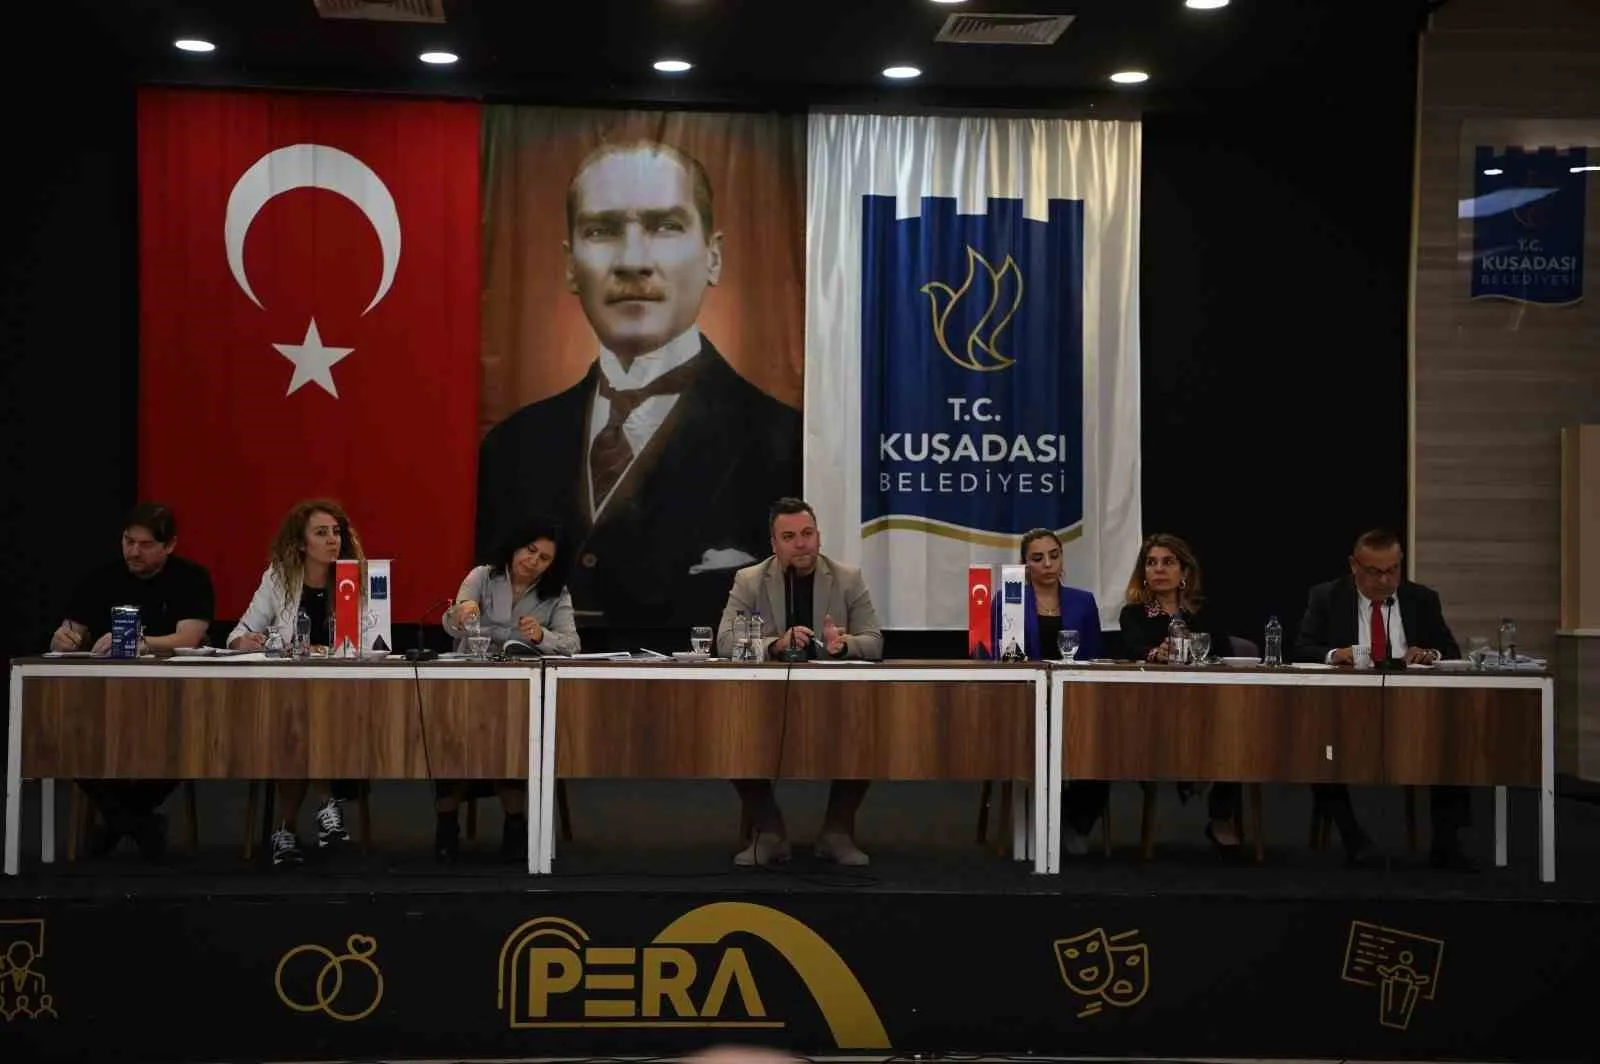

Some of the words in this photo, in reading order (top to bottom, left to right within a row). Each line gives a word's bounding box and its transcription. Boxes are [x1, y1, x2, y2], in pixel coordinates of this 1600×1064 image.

[1516, 238, 1544, 253] T.C.
[947, 397, 1002, 422] T.C.
[879, 432, 1067, 464] KUŞADASI
[879, 468, 1066, 494] BELEDİYESİ
[528, 947, 767, 1017] PERA
